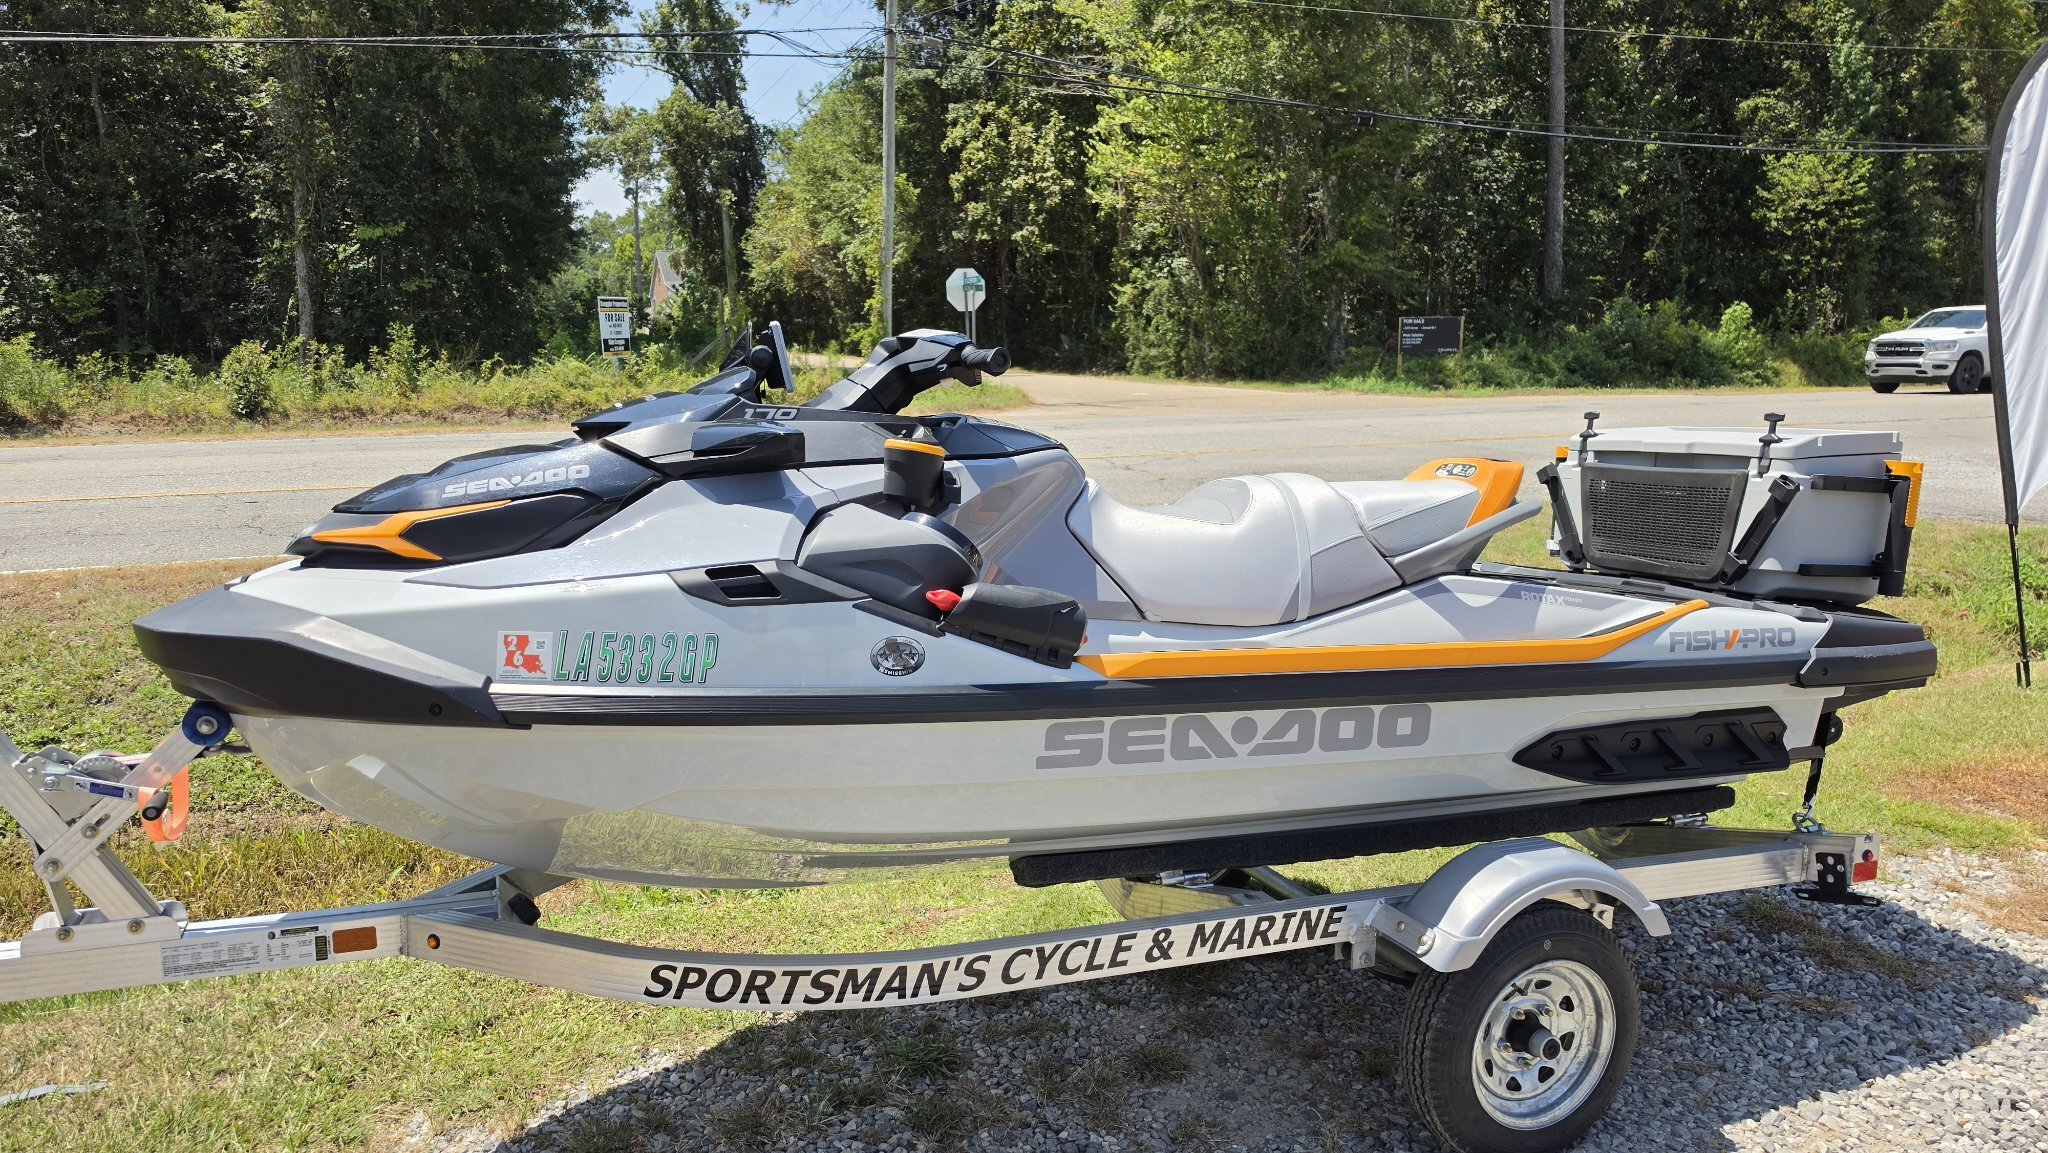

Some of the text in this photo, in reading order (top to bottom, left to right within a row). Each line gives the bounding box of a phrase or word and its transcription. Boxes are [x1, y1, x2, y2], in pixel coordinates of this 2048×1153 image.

[744, 408, 798, 420] 170
[1520, 590, 1567, 606] ROTAX
[553, 629, 720, 684] LA5332GP
[643, 905, 1348, 1005] SPORTSMAN'S CYCLE & MARINE
